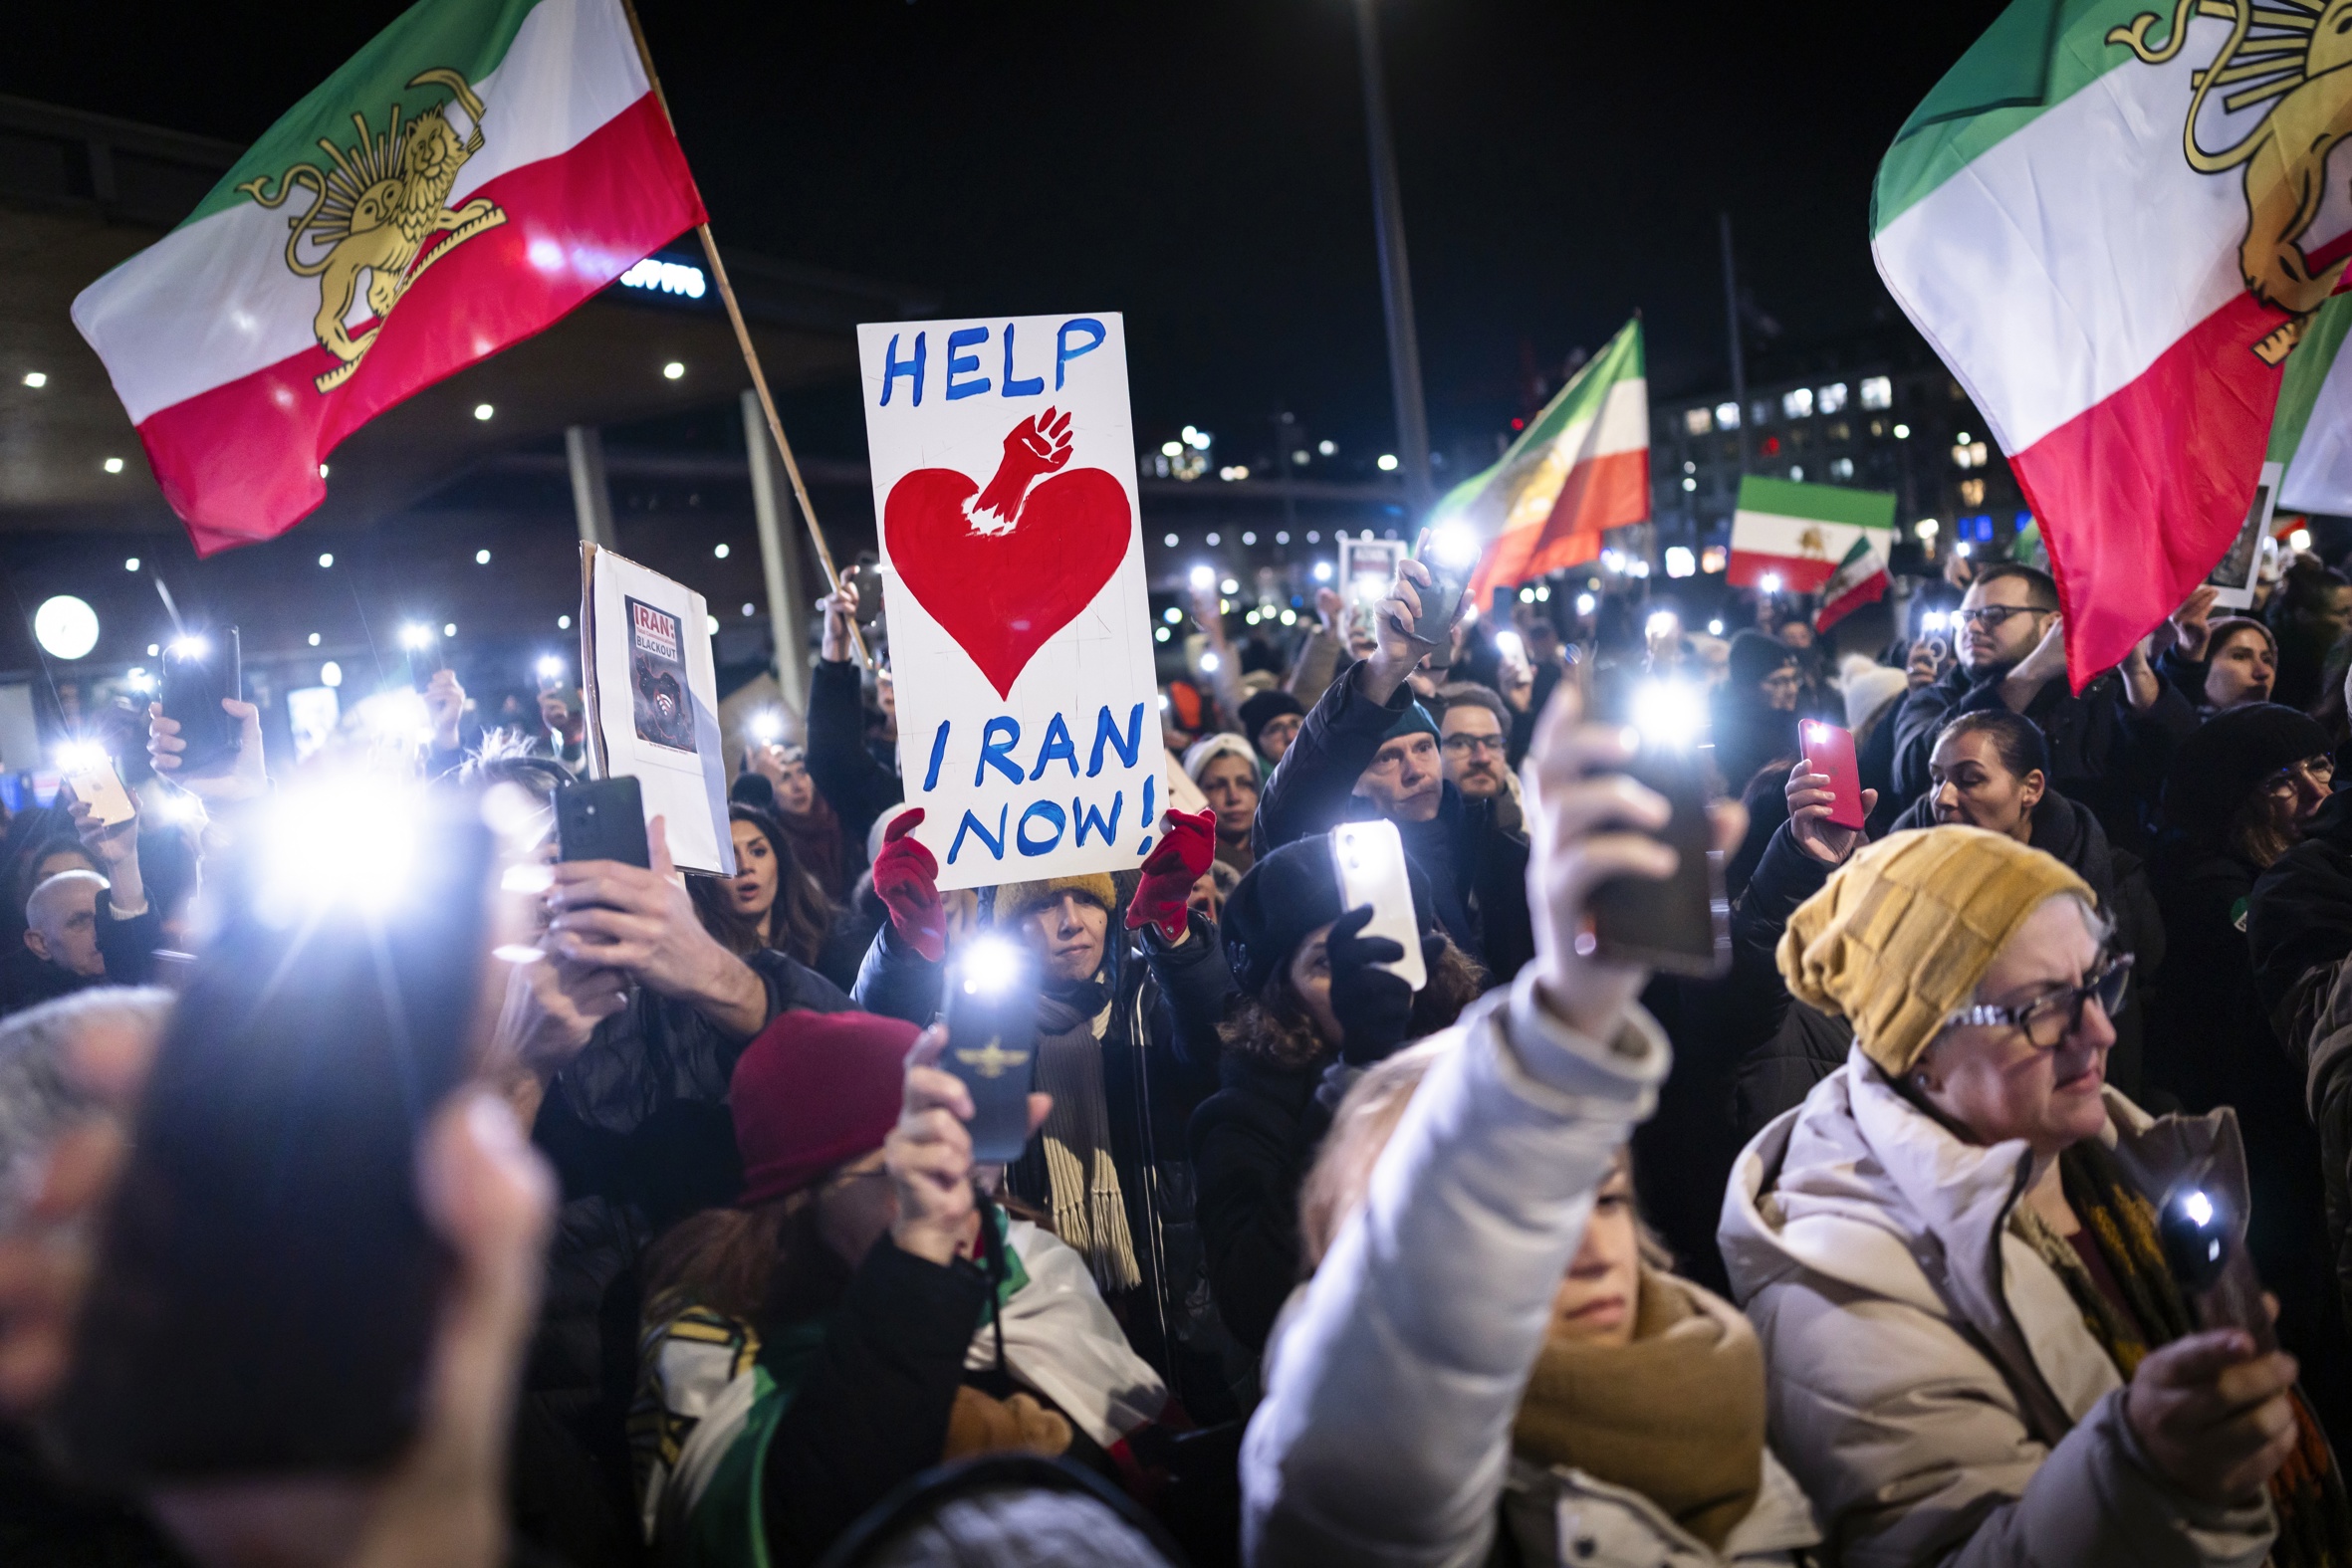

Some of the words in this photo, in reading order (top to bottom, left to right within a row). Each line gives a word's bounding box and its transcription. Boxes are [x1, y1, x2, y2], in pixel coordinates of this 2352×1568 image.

[879, 318, 1107, 408] HELP
[634, 604, 675, 639] IRAN:
[636, 634, 676, 659] BLACKOUT
[922, 702, 1144, 792] IRAN
[947, 774, 1155, 865] NOW!
